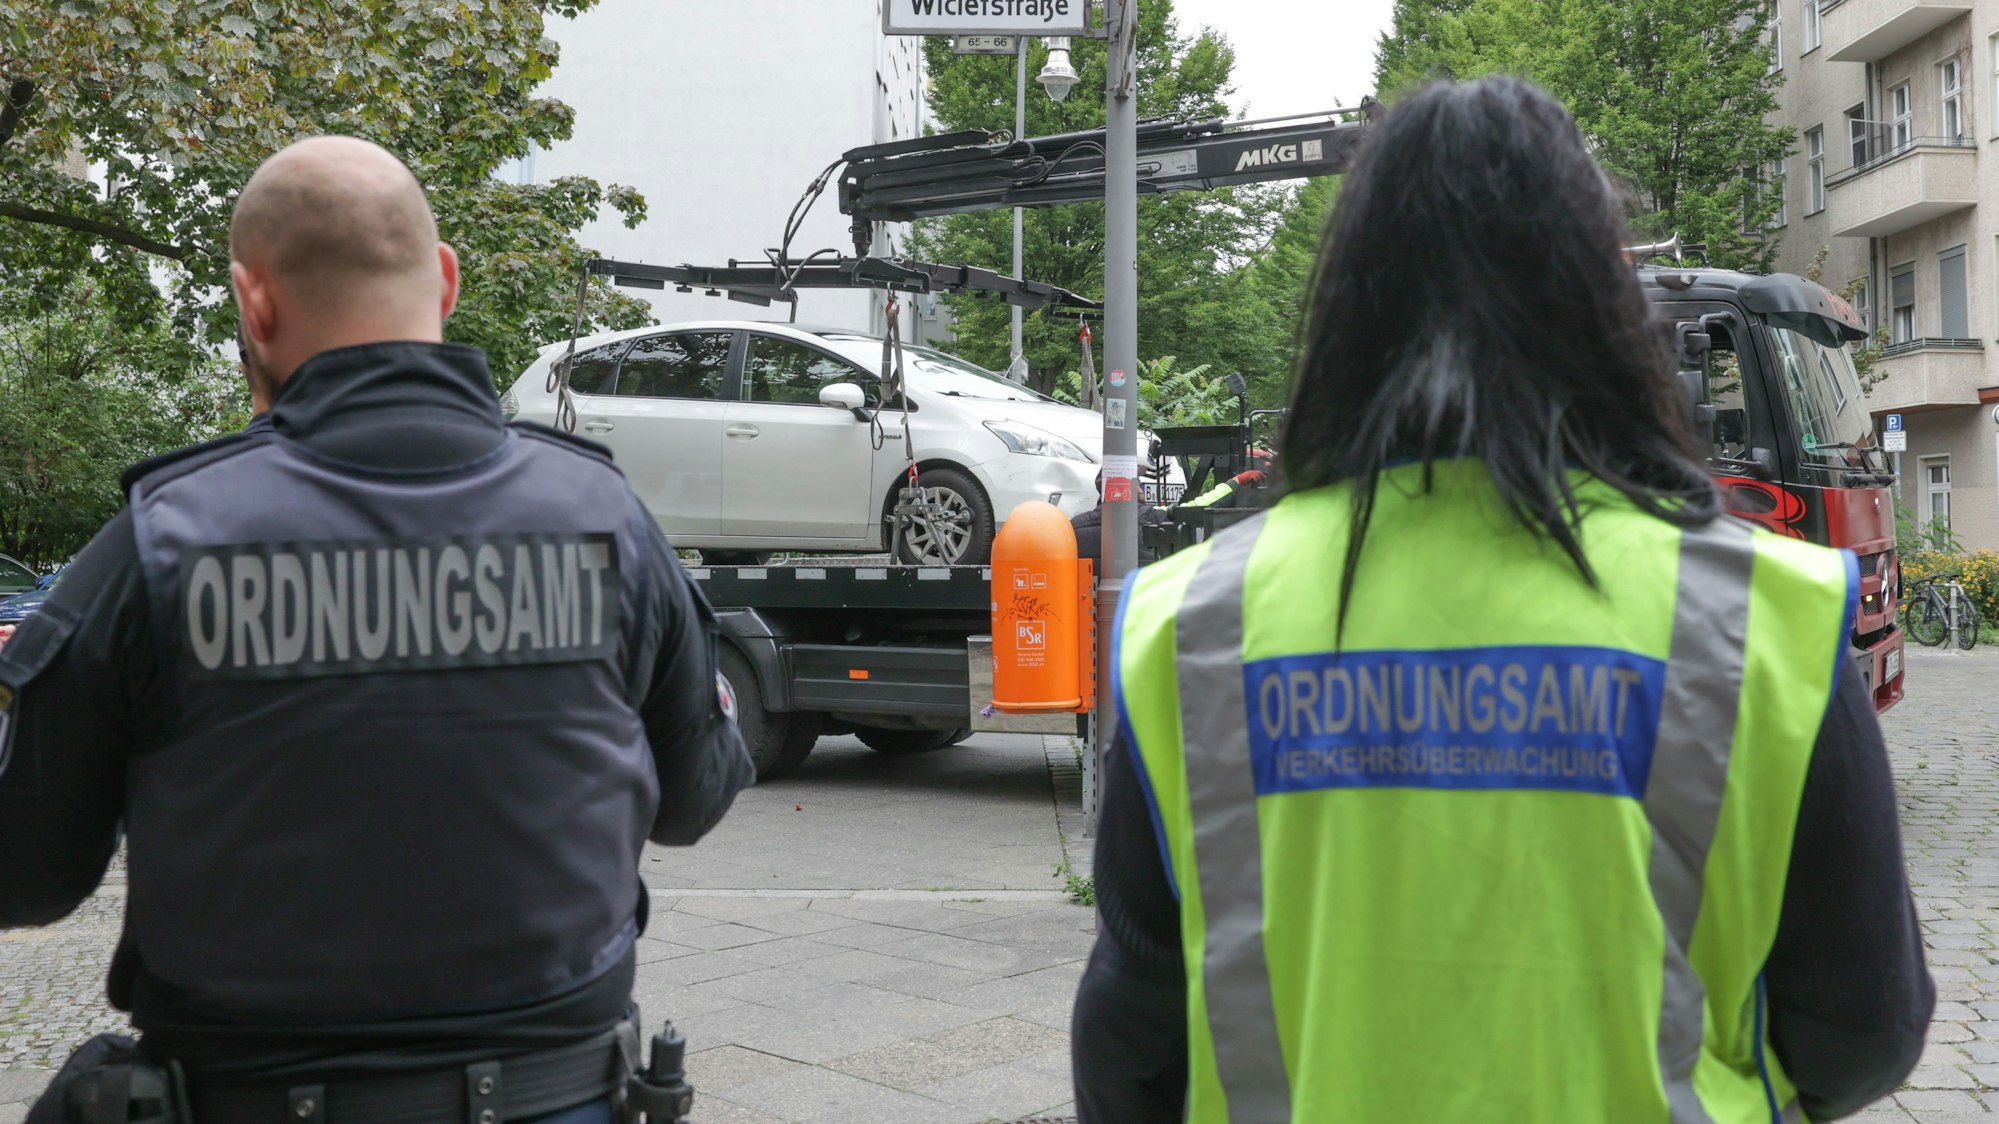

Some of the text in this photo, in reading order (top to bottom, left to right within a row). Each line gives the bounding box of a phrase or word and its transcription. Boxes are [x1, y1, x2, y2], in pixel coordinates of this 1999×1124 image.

[968, 37, 982, 47] 65
[993, 37, 1008, 47] 66
[1234, 143, 1298, 172] MKG
[187, 542, 610, 670] ORDNUNGSAMT
[1019, 626, 1042, 645] BSR
[1258, 662, 1641, 741] ORDNUNGSAMT
[1275, 741, 1619, 780] VERKEHRSÜBERWACHUNG
